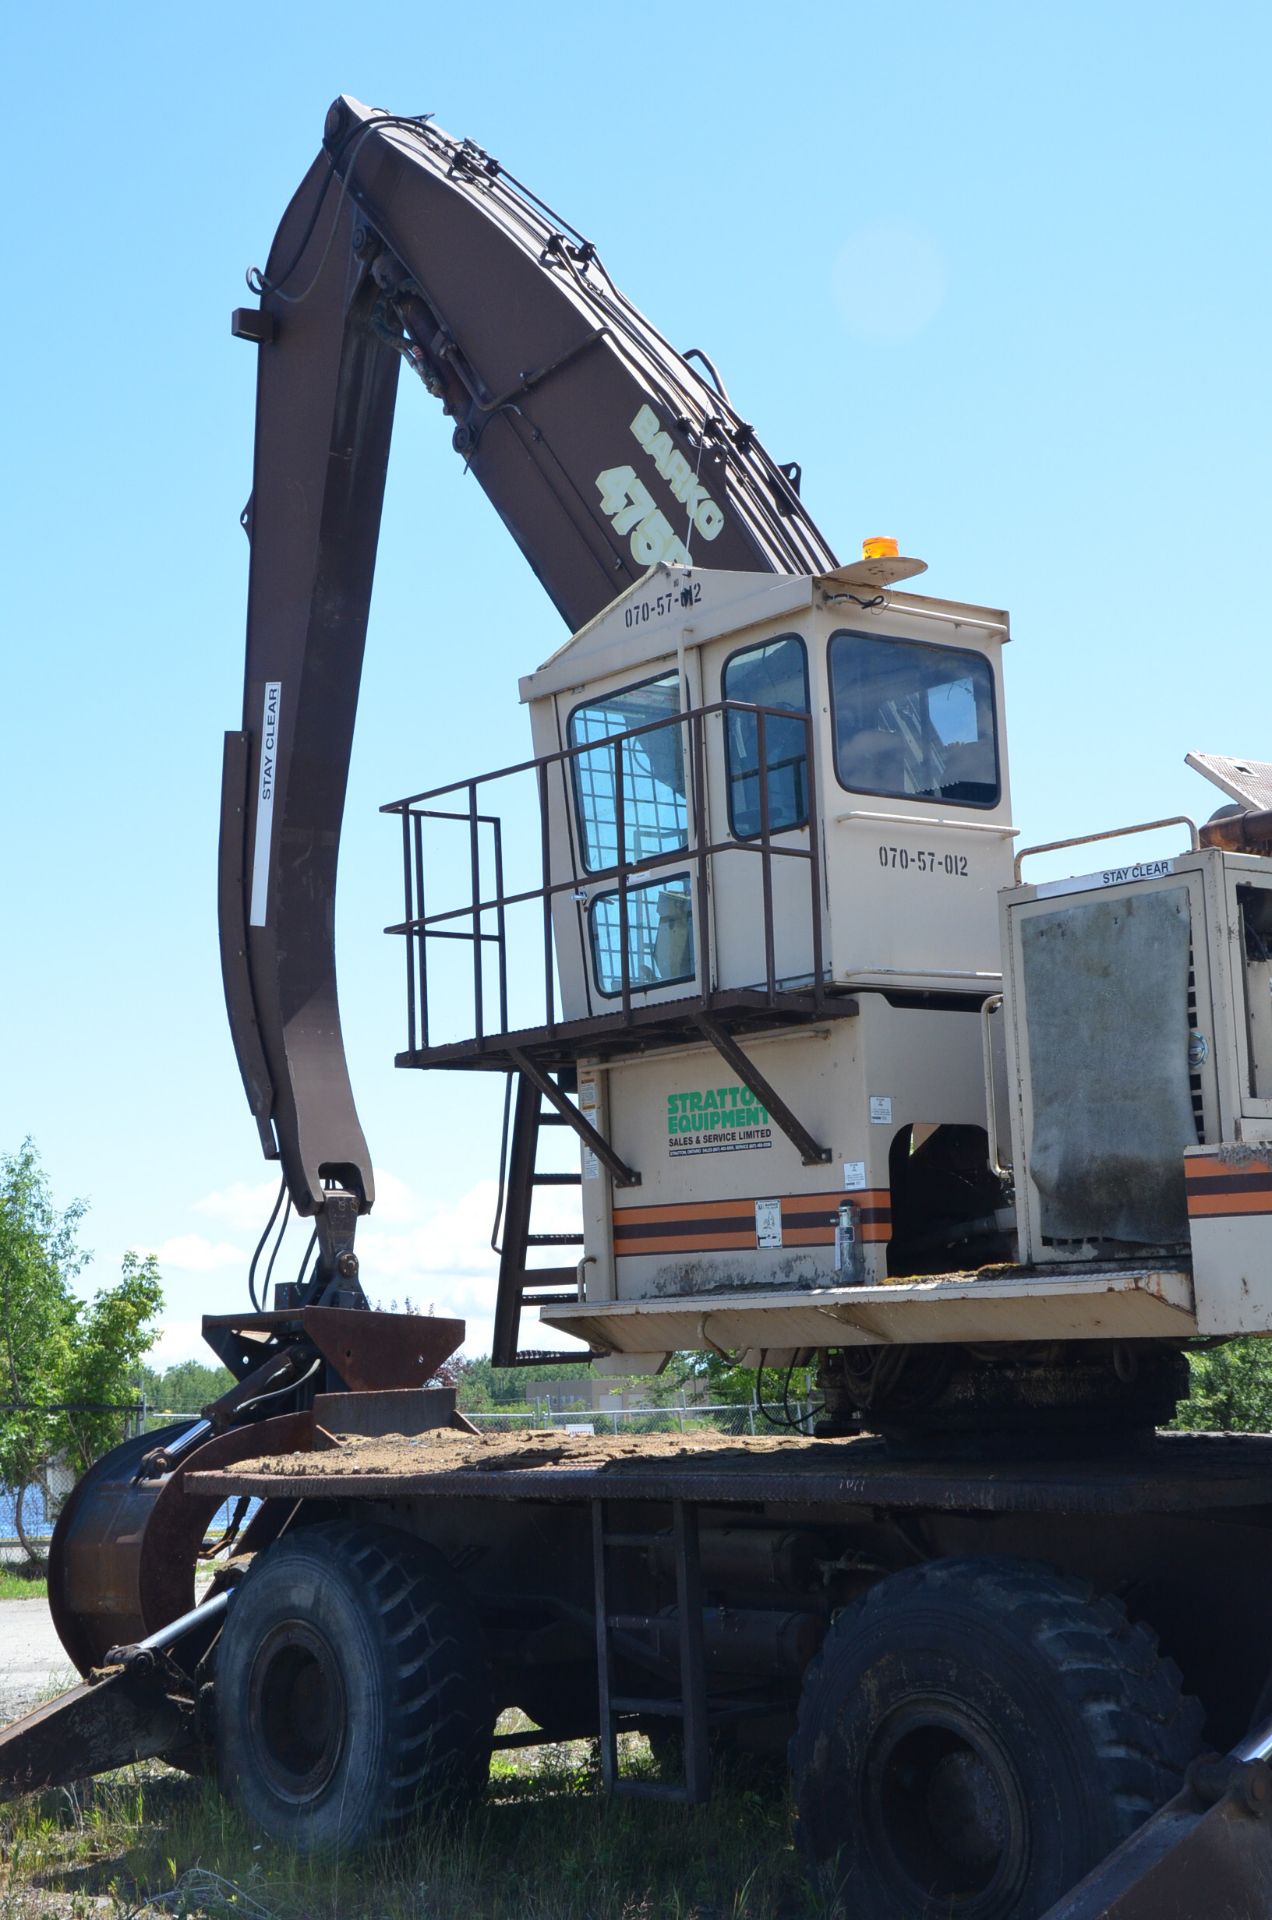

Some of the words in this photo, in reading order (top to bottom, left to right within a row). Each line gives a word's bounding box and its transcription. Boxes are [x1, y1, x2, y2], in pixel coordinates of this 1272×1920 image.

[629, 403, 725, 541] BARKO
[265, 688, 278, 750] CLEAR
[262, 756, 273, 800] STAY
[879, 846, 968, 877] 070-57-012
[1103, 869, 1129, 884] STAY
[1131, 861, 1169, 878] CLEAR
[667, 1086, 761, 1115] STRATTO
[668, 1106, 769, 1135] EQUIPMENT
[669, 1138, 694, 1147] SALES
[695, 1135, 702, 1144] &
[703, 1132, 736, 1144] SERVICE
[738, 1129, 772, 1140] LIMITED
